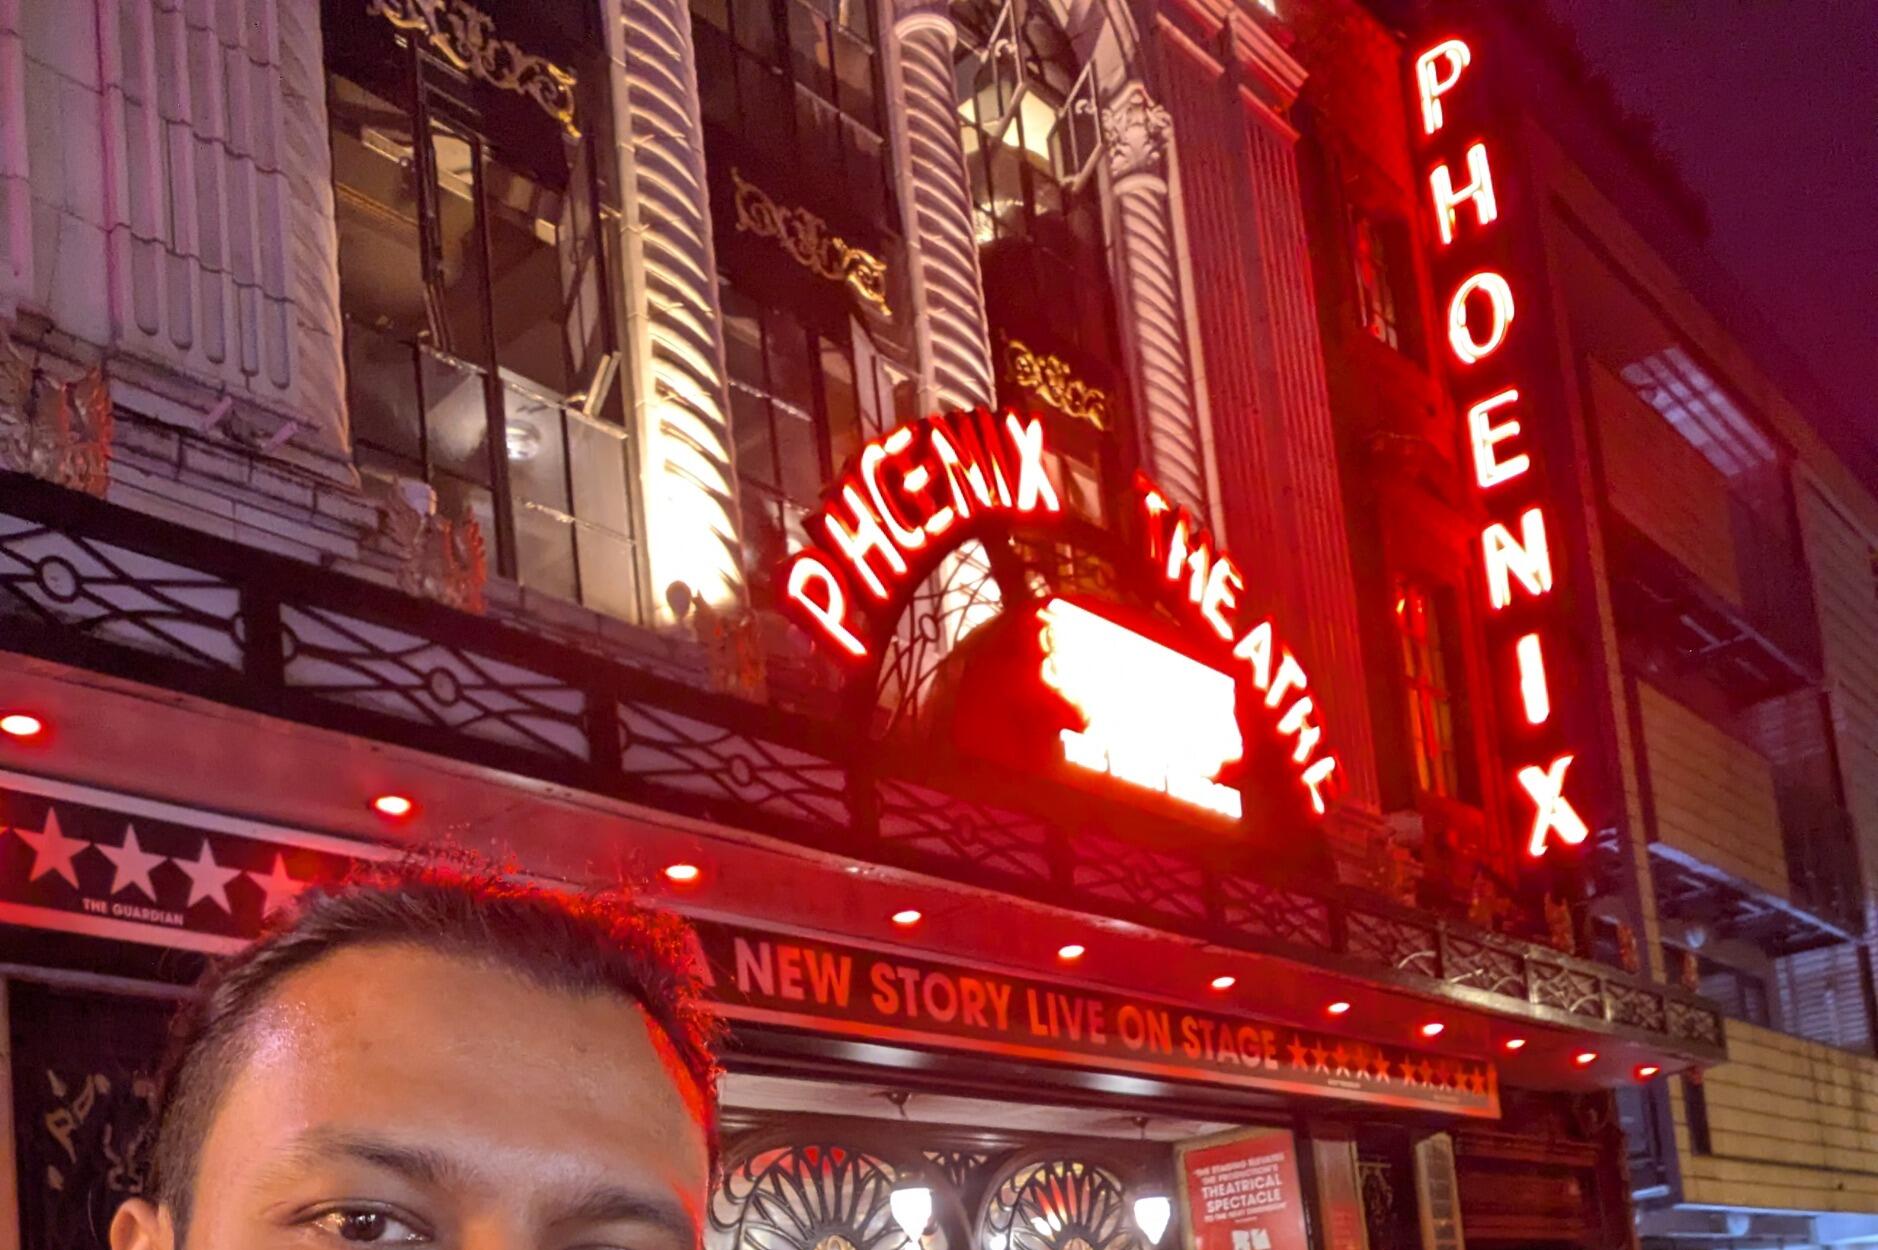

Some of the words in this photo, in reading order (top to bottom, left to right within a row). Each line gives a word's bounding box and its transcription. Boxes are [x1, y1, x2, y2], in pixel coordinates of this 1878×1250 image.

[1414, 36, 1590, 860] PHOENIX
[82, 898, 108, 914] THE
[112, 903, 184, 926] GUARDIAN
[734, 936, 852, 1007] NEW
[871, 962, 1012, 1032] STORY
[1027, 988, 1107, 1045] LIVE
[1117, 1005, 1173, 1056] ON
[1181, 1015, 1279, 1070] STAGE
[1202, 1173, 1283, 1200] THEATRICAL
[1206, 1188, 1282, 1213] SPECTACLE
